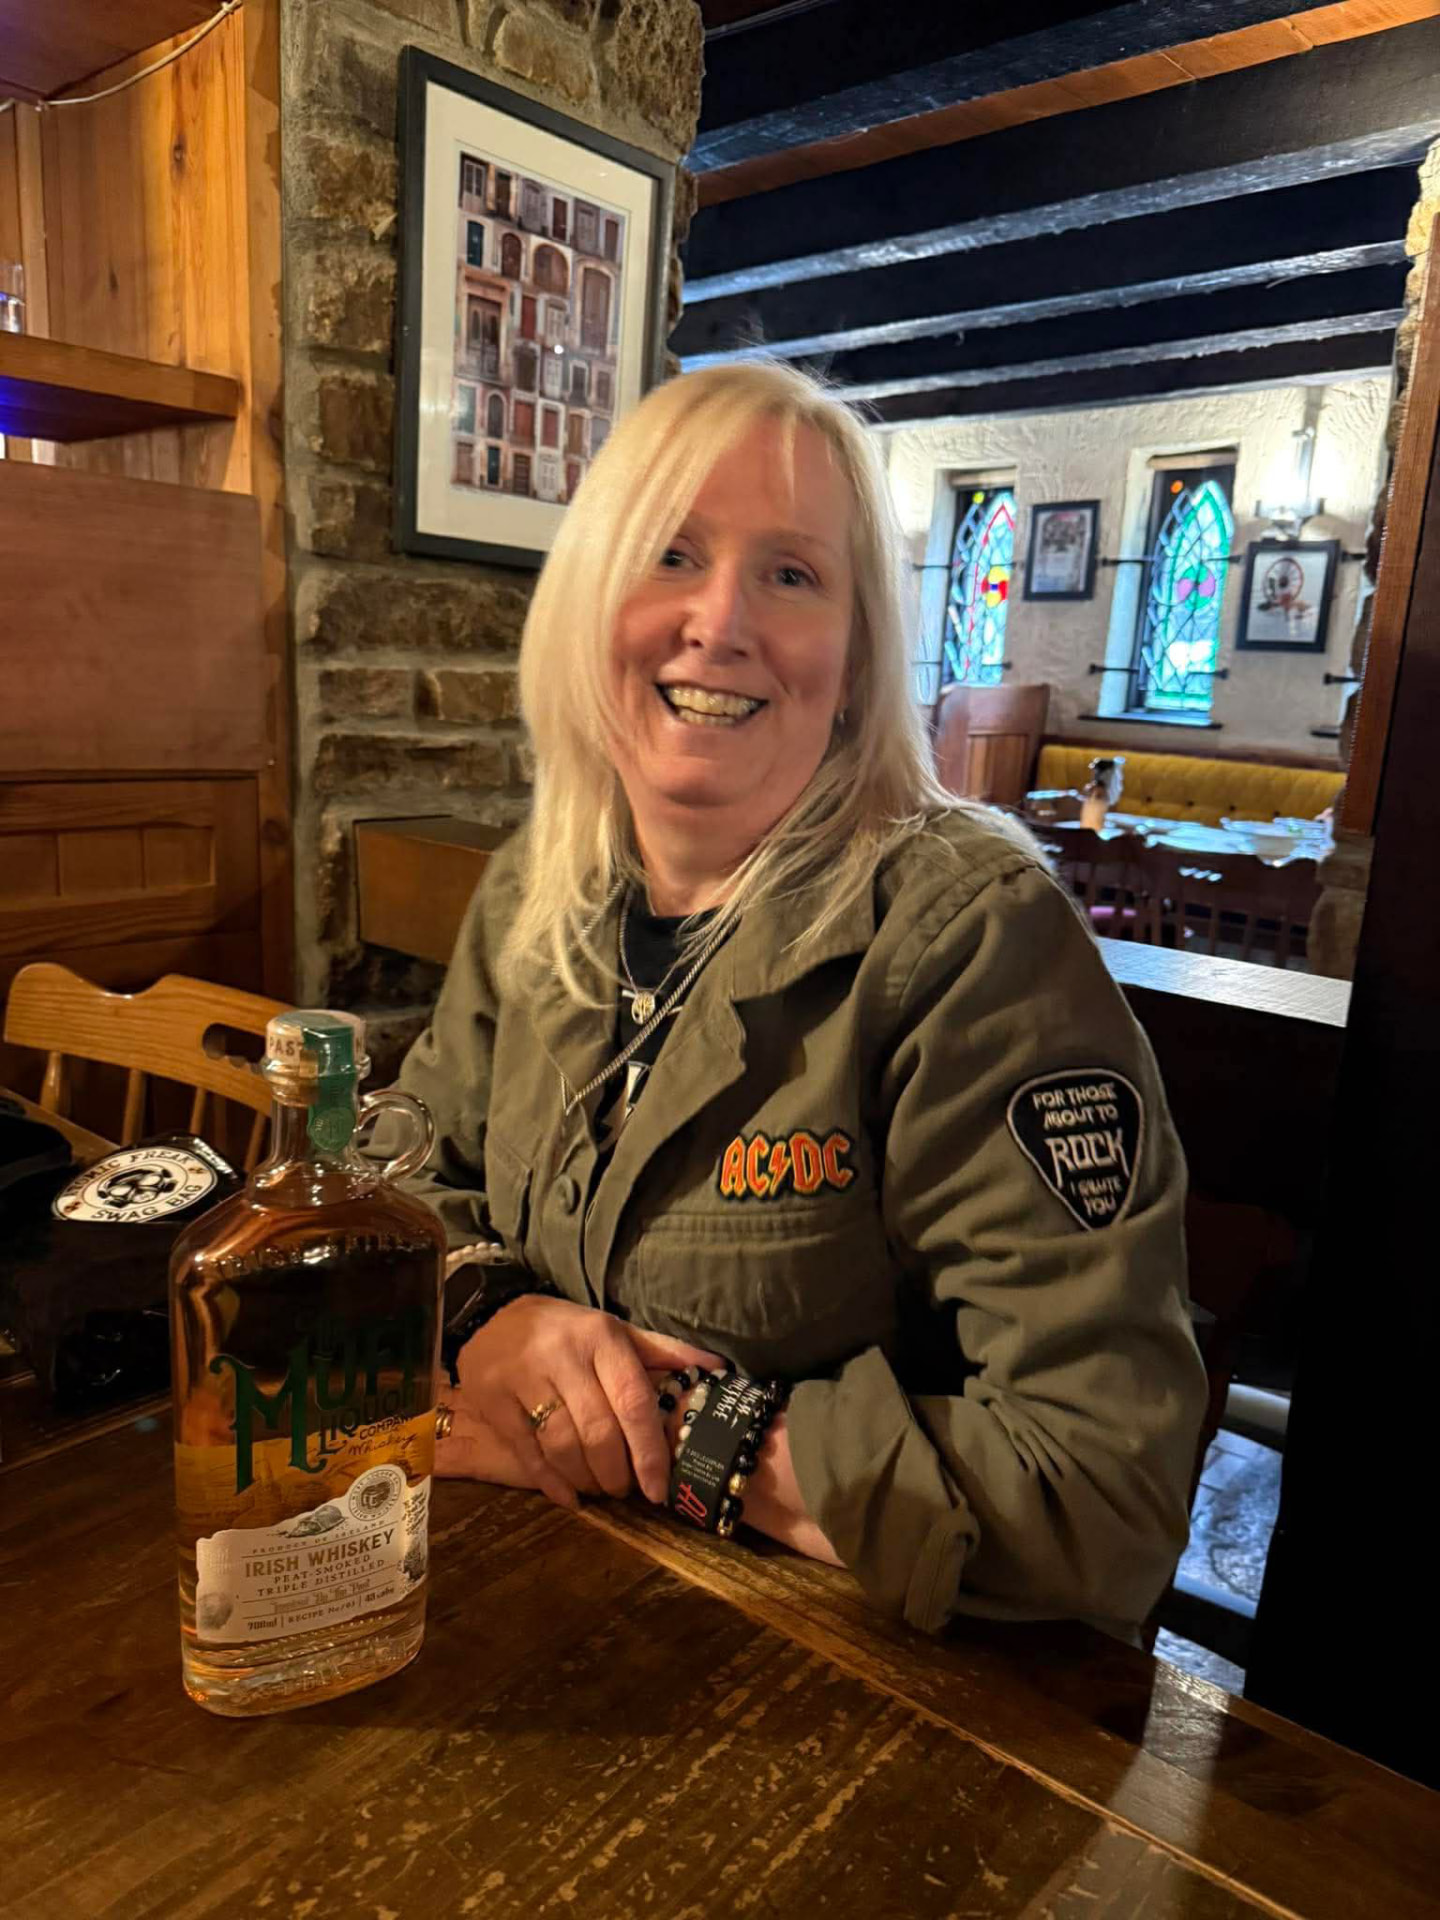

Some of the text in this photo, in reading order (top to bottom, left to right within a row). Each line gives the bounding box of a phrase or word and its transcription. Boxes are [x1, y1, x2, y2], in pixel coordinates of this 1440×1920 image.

[1032, 1082, 1118, 1111] FOR THOSE
[1043, 1103, 1119, 1129] ABOUT TO
[129, 1149, 193, 1166] FREAK
[1044, 1127, 1131, 1190] ROCK
[91, 1183, 203, 1222] SWAG BAG
[1083, 1195, 1117, 1218] YOU
[251, 1541, 308, 1554] PRODUCT
[335, 1519, 386, 1539] IRELAND
[245, 1528, 396, 1578] IRISH WHISKEY
[257, 1559, 386, 1597] TRIPLE DISTILLED
[274, 1554, 371, 1585] PEAT-SMOKED
[287, 1609, 325, 1624] RECIPE
